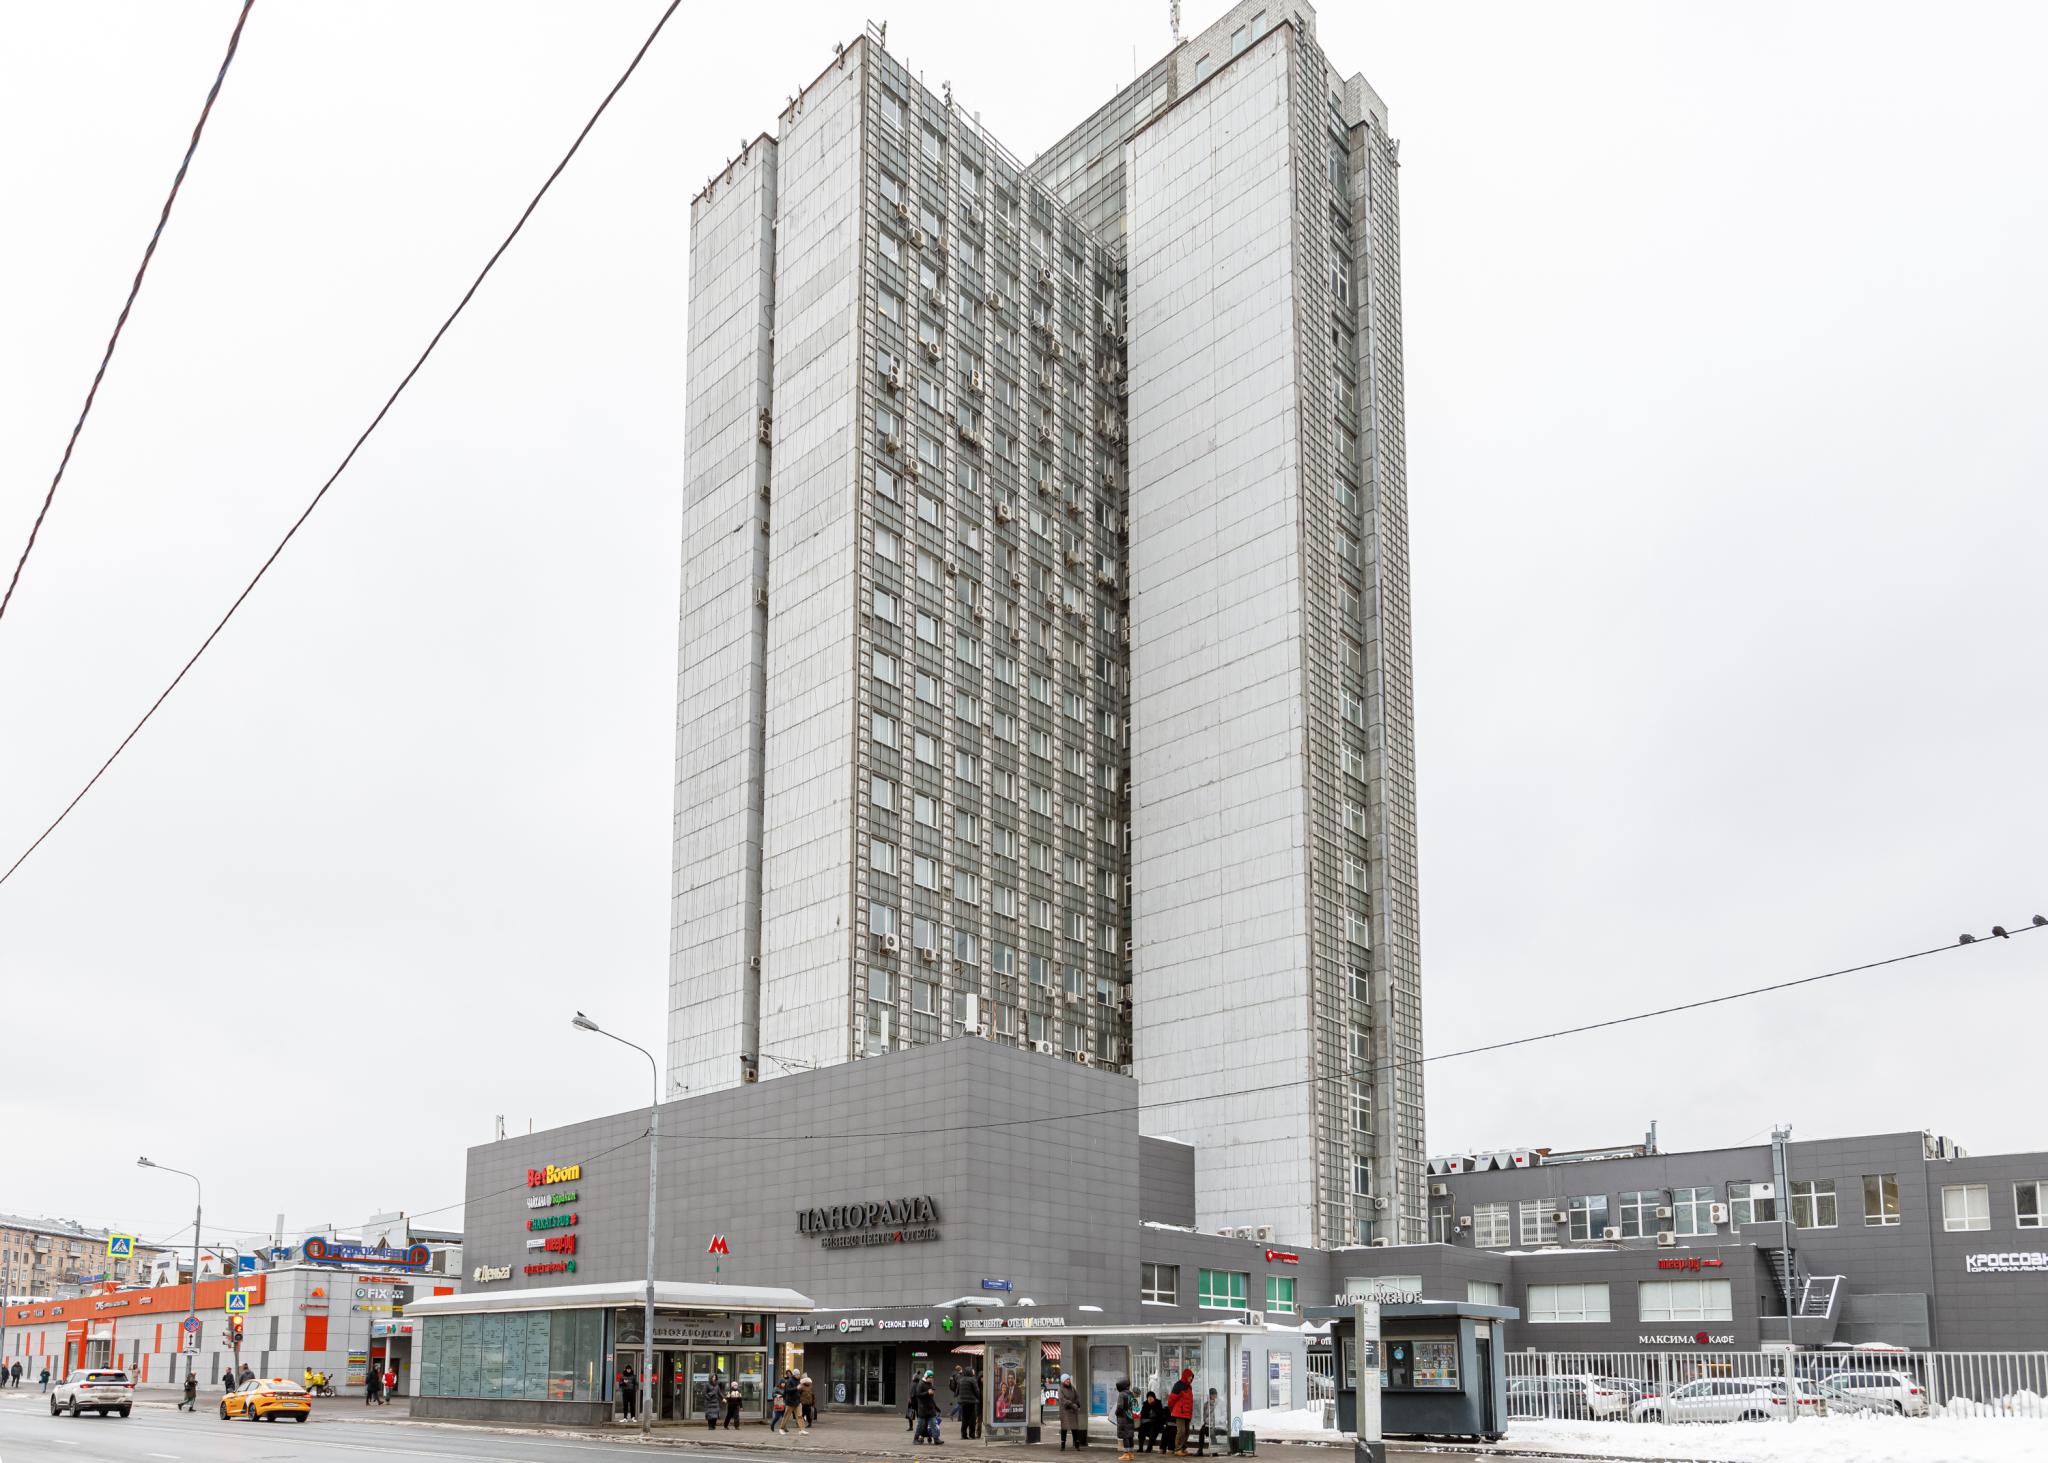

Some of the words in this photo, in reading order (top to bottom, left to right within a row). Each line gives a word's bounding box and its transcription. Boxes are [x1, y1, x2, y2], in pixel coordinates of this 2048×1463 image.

[527, 1164, 581, 1188] BetBoom
[795, 1195, 938, 1235] ПАНОРАМА
[821, 1235, 859, 1248] БИЗНЕС
[861, 1232, 892, 1246] ЦЕНТР
[902, 1227, 937, 1241] ОТЕЛЬ
[1335, 1291, 1423, 1307] МОРОЖЕНОЕ
[849, 1317, 875, 1327] АПТЕКА
[884, 1320, 906, 1329] СЕКОНД
[744, 1324, 752, 1334] 3
[1638, 1335, 1697, 1344] МАКСИМА
[1708, 1335, 1736, 1344] КАФЕ
